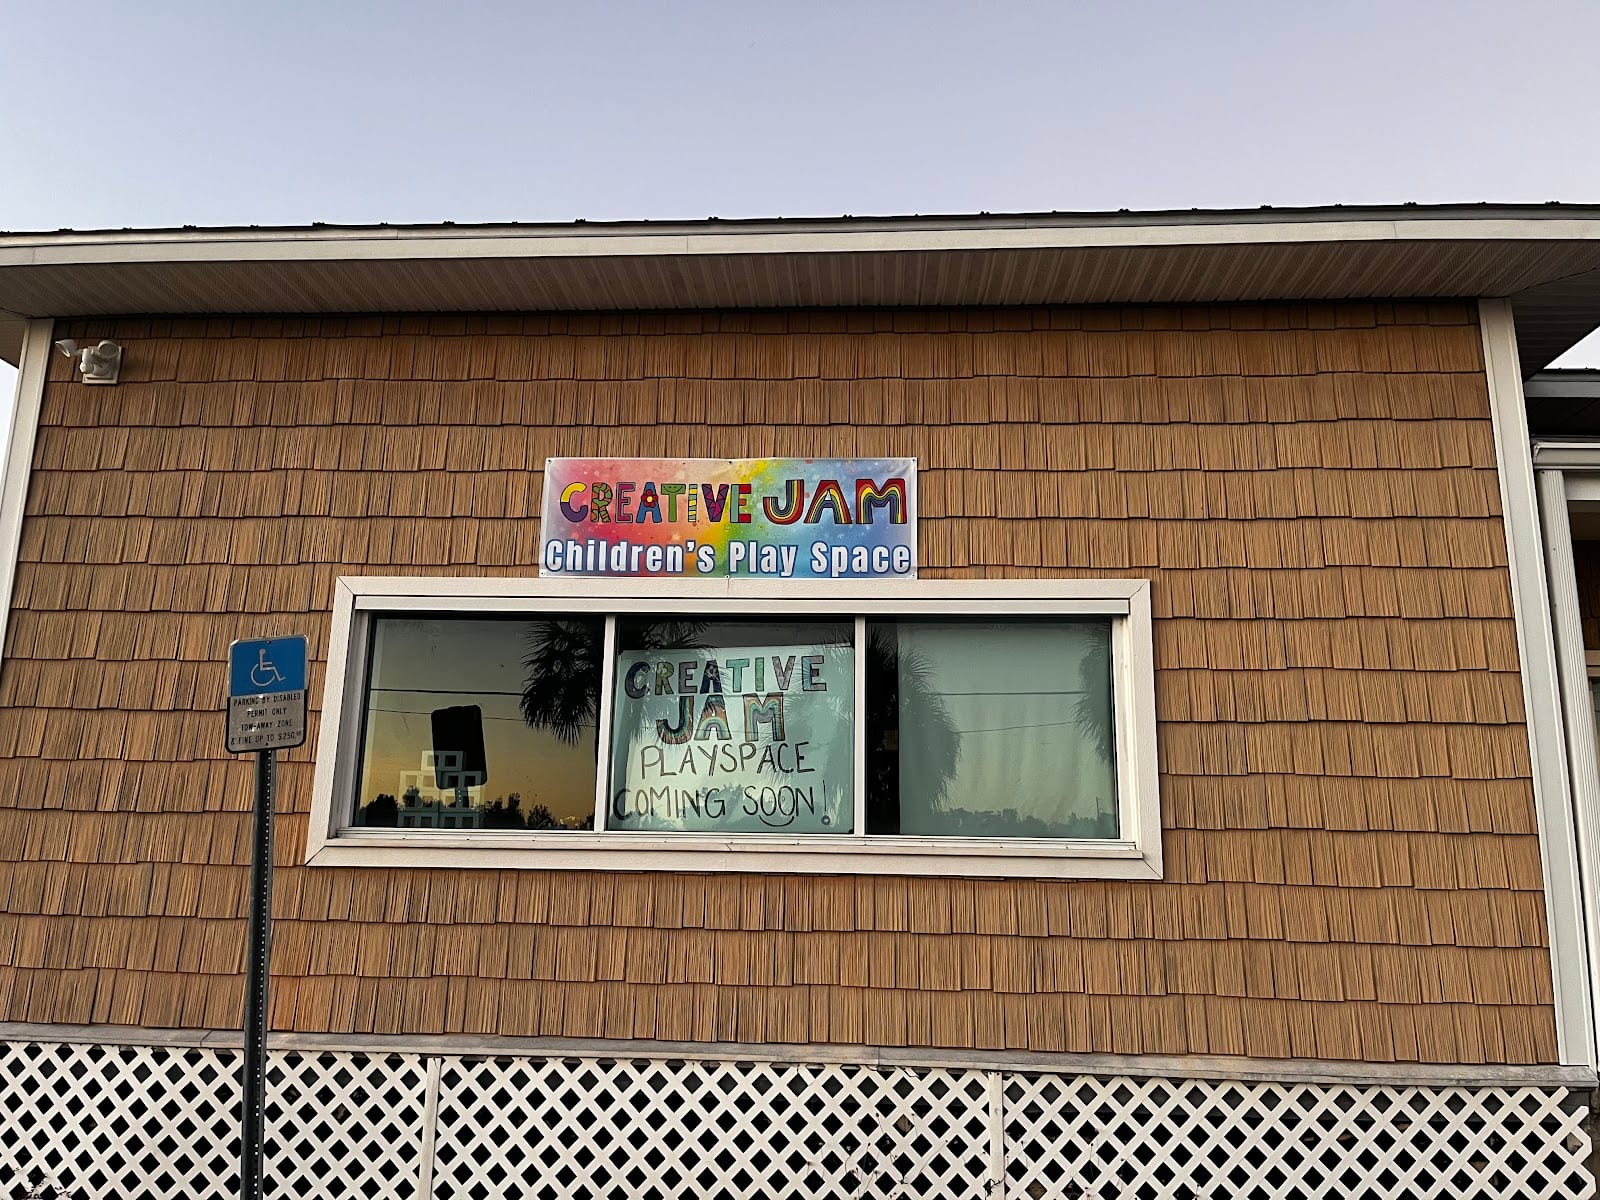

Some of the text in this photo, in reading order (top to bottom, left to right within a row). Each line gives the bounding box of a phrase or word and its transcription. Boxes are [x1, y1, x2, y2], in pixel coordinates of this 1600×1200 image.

[560, 479, 908, 525] CREATIVE JAM
[545, 538, 912, 578] Children's Play Space
[624, 655, 827, 699] CREATIVE
[234, 697, 259, 706] PARKING
[274, 693, 300, 702] DISABLED
[248, 709, 268, 718] PERMIT
[656, 692, 786, 744] JAM
[241, 719, 292, 732] TOW-AWAY ZONE
[640, 742, 815, 779] PLAYSPACE
[613, 780, 831, 825] COMING SOON!
